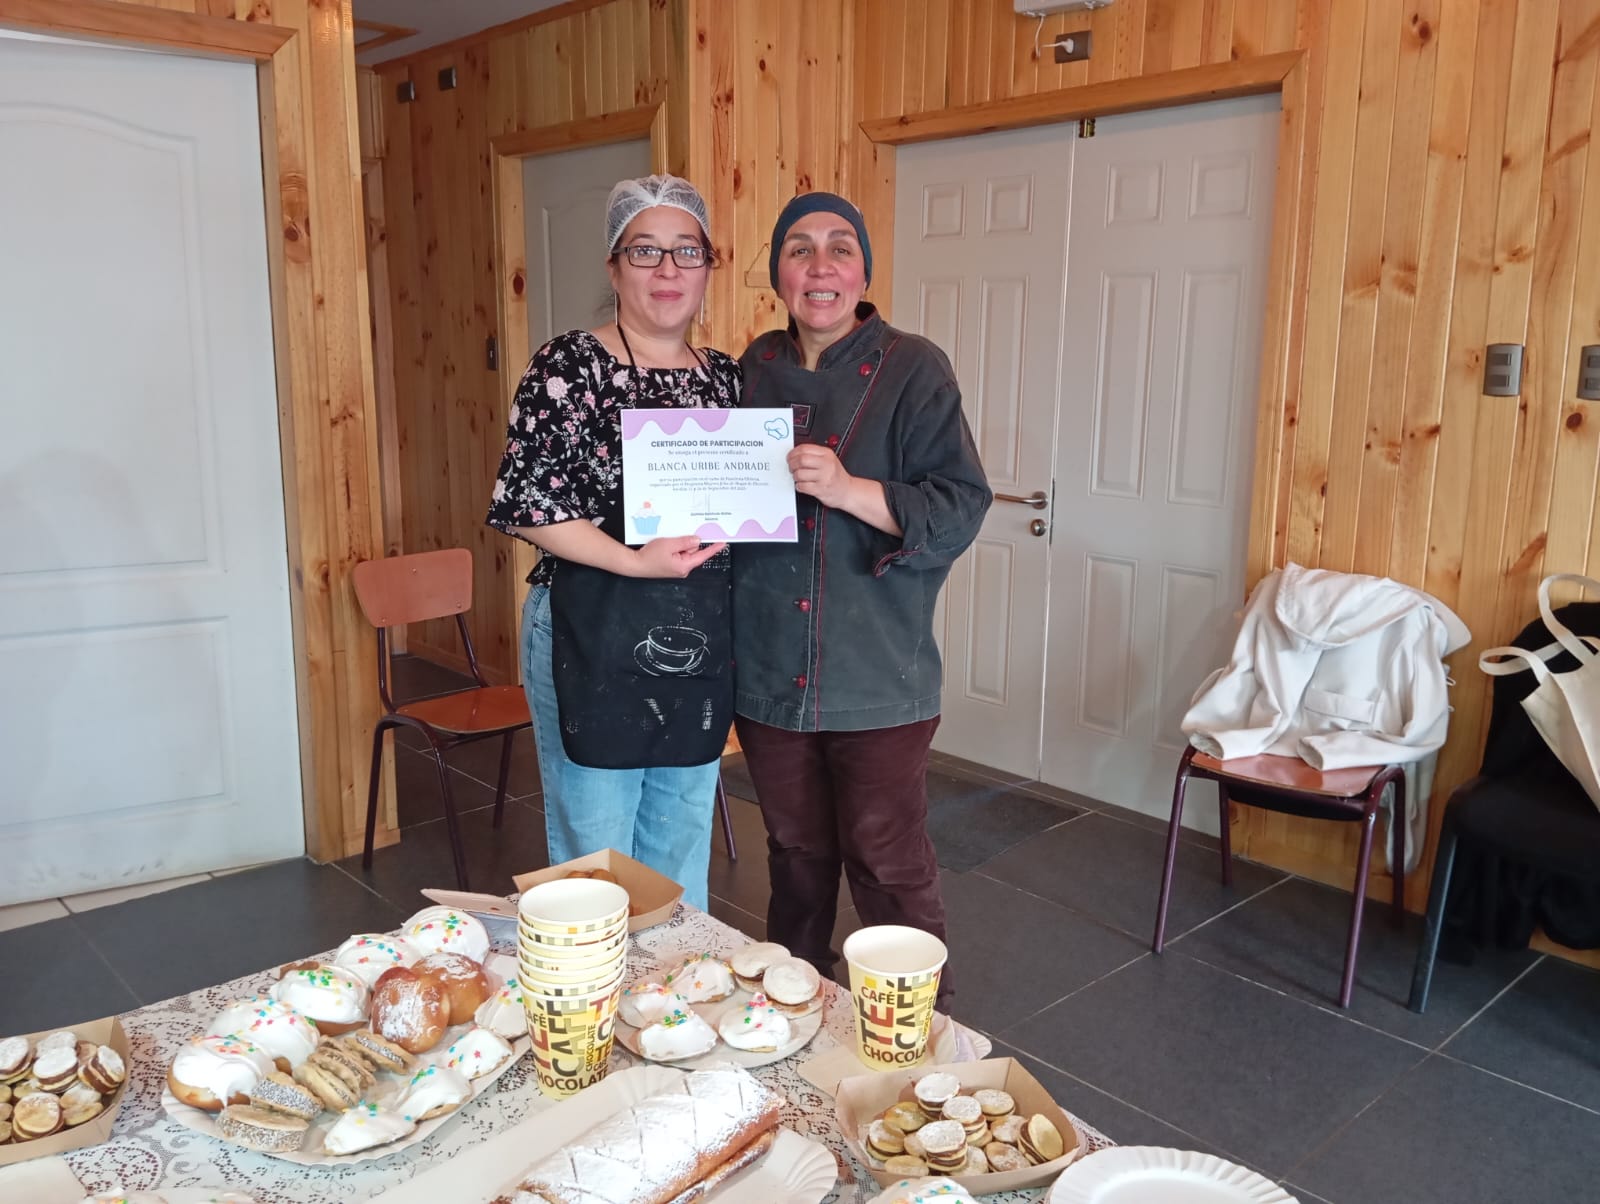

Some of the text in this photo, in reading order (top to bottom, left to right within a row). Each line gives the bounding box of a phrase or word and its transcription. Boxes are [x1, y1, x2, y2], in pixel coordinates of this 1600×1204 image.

[648, 461, 770, 471] BLANCA URIBE ANDRADE
[861, 986, 895, 1005] CAFÉ
